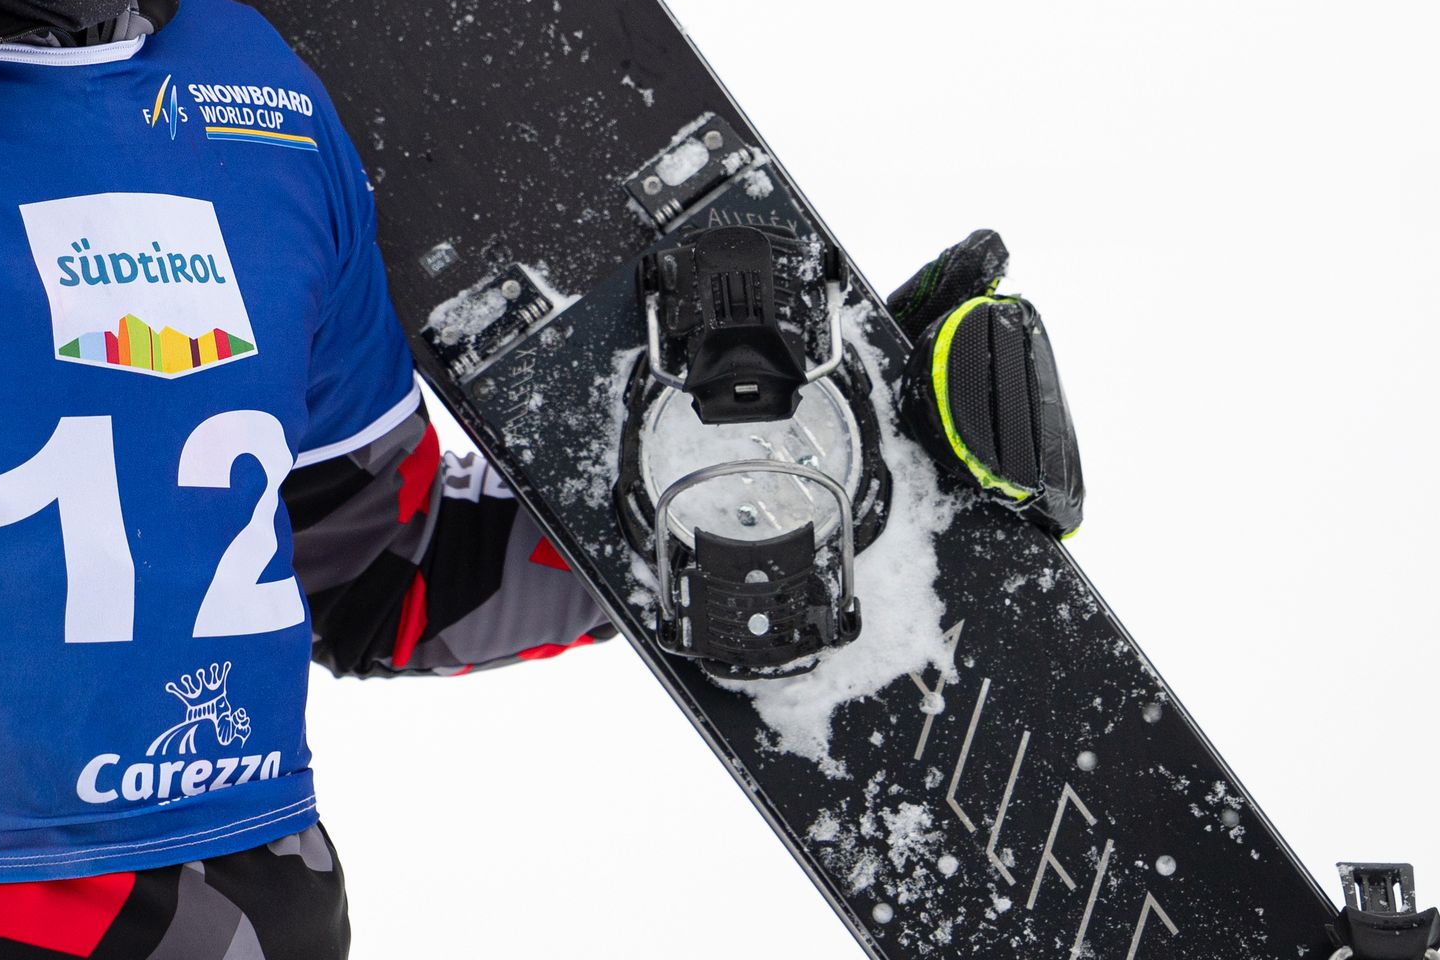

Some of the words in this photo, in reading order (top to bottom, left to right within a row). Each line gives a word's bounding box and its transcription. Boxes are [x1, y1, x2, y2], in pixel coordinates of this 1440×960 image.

[188, 84, 313, 117] SNOWBOARD
[199, 105, 255, 126] WORLD
[256, 109, 284, 130] CUP
[76, 751, 282, 804] Carezza
